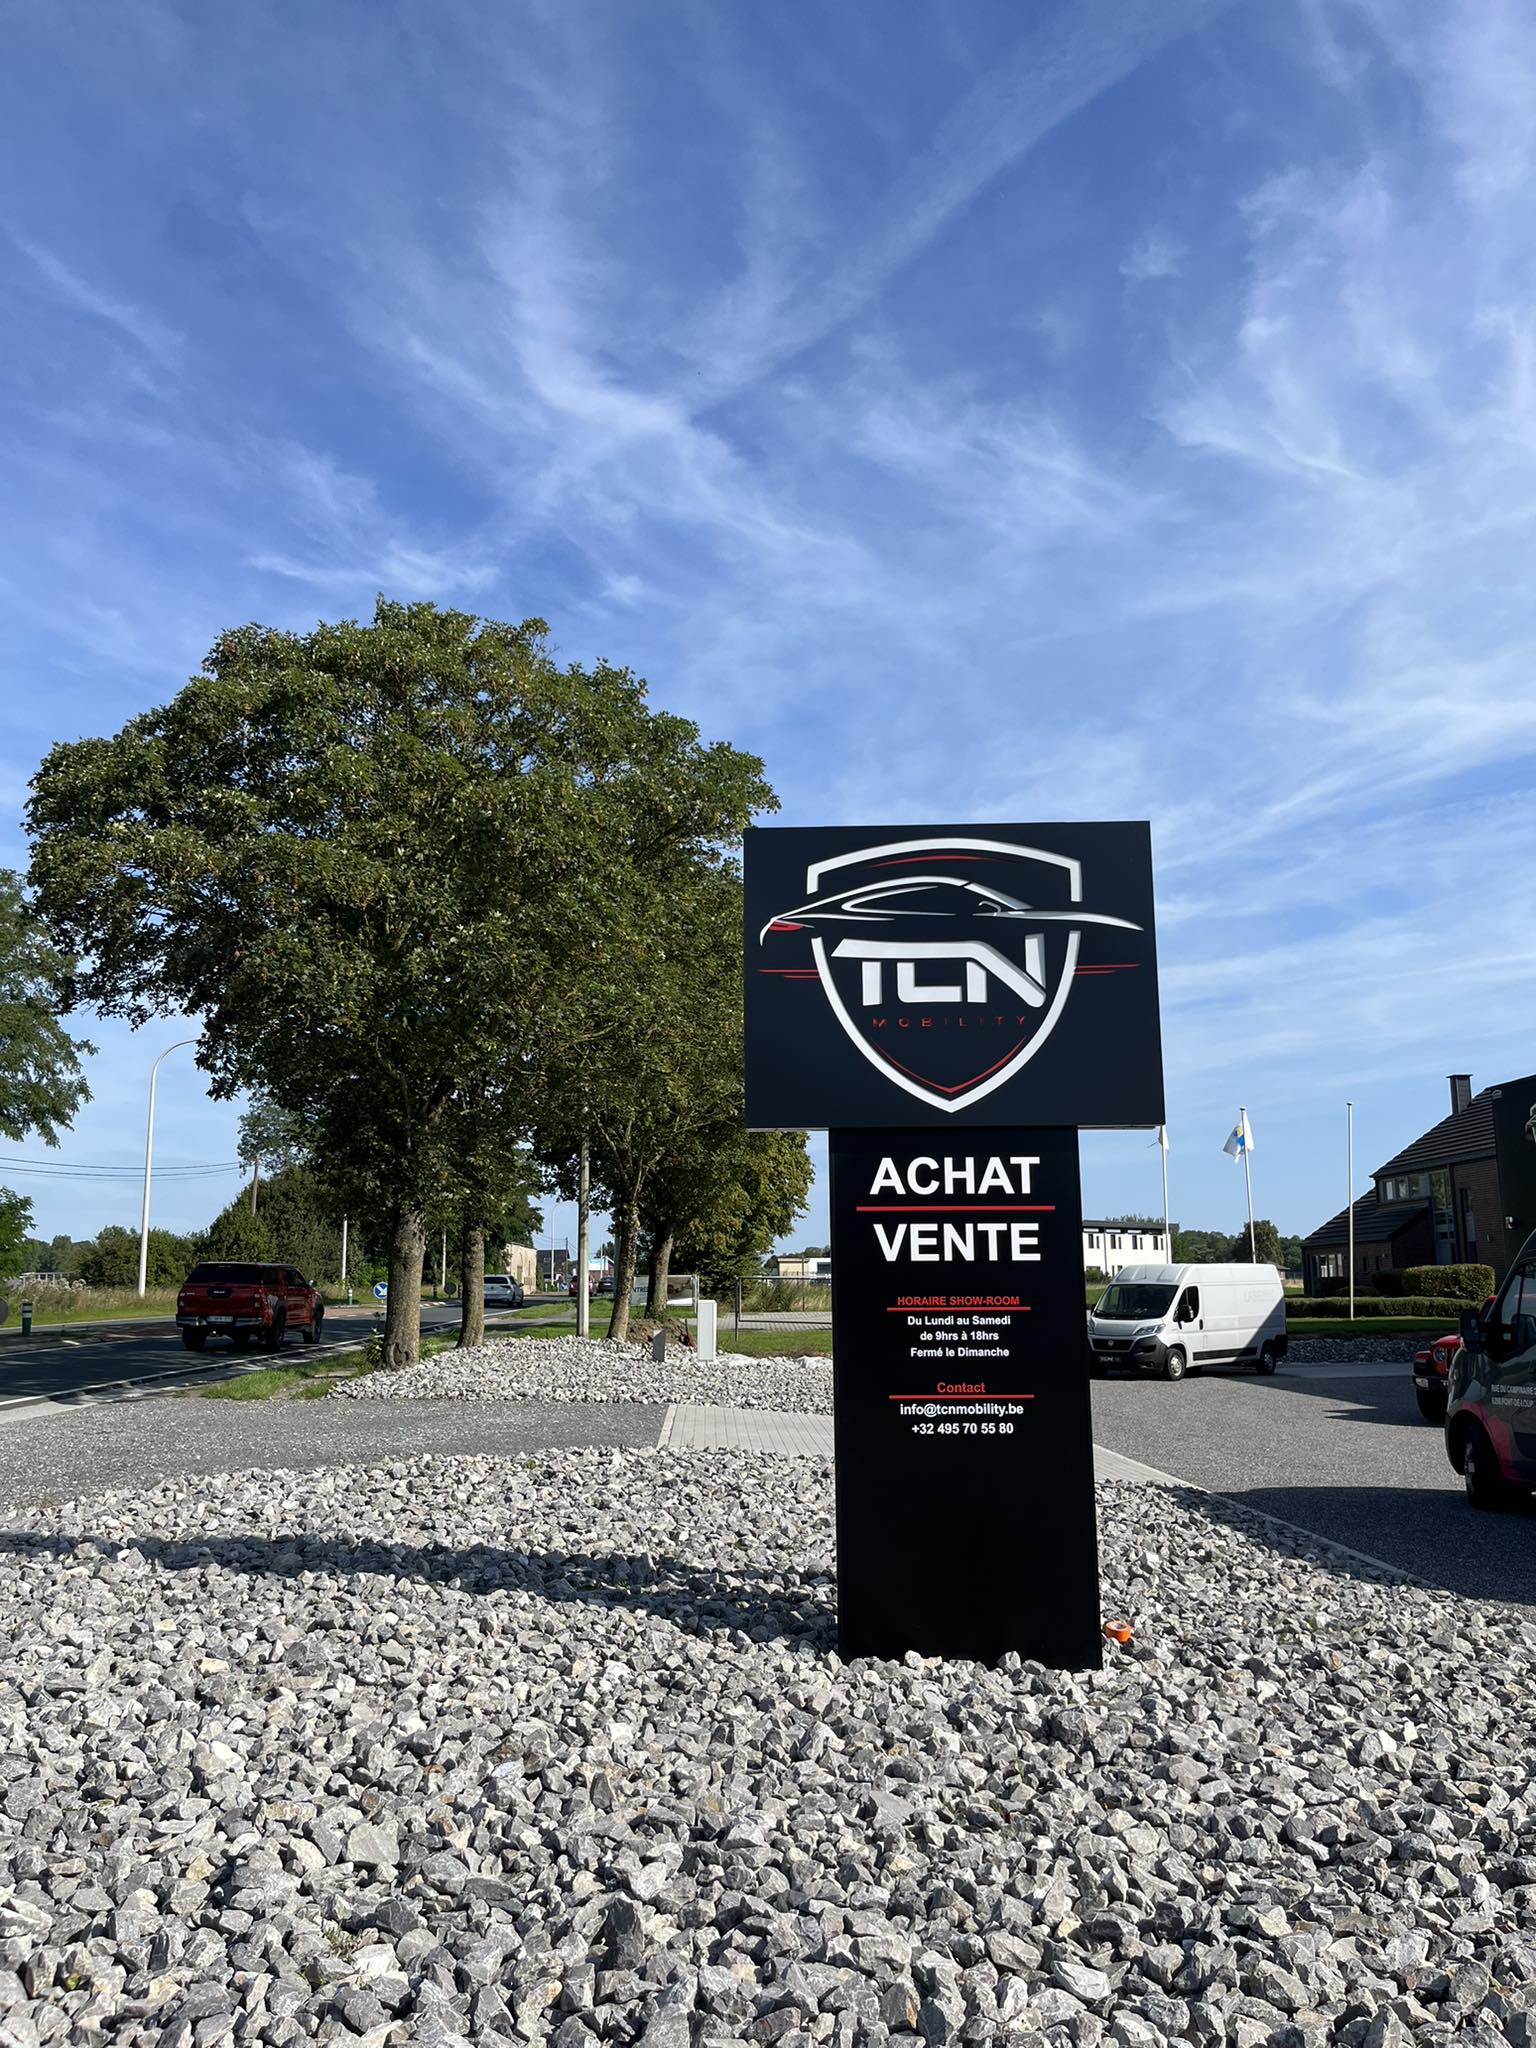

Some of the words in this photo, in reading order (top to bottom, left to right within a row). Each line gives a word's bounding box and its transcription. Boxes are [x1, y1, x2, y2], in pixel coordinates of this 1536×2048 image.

[872, 1015, 1026, 1028] MOBILITY
[869, 1156, 1041, 1195] ACHAT
[873, 1222, 1042, 1262] VENTE
[897, 1296, 947, 1306] HORAIRE
[949, 1295, 1020, 1306] SHOW-ROOM
[907, 1315, 923, 1326] Du
[924, 1315, 955, 1326] Lundi
[956, 1317, 970, 1326] au
[971, 1315, 1011, 1326] Samedi
[919, 1331, 933, 1341] de
[934, 1331, 959, 1341] 9hrs
[960, 1330, 968, 1341] à
[969, 1330, 1000, 1341] 18hrs
[910, 1346, 944, 1357] Fermé
[945, 1347, 956, 1357] le
[957, 1347, 1010, 1357] Dimanche
[936, 1381, 986, 1393] Contact
[899, 1403, 1024, 1417] info@tcnmobility.be
[911, 1423, 935, 1435] +32
[937, 1422, 960, 1435] 495
[962, 1422, 978, 1435] 70
[980, 1422, 997, 1435] 55
[998, 1422, 1014, 1435] 80
